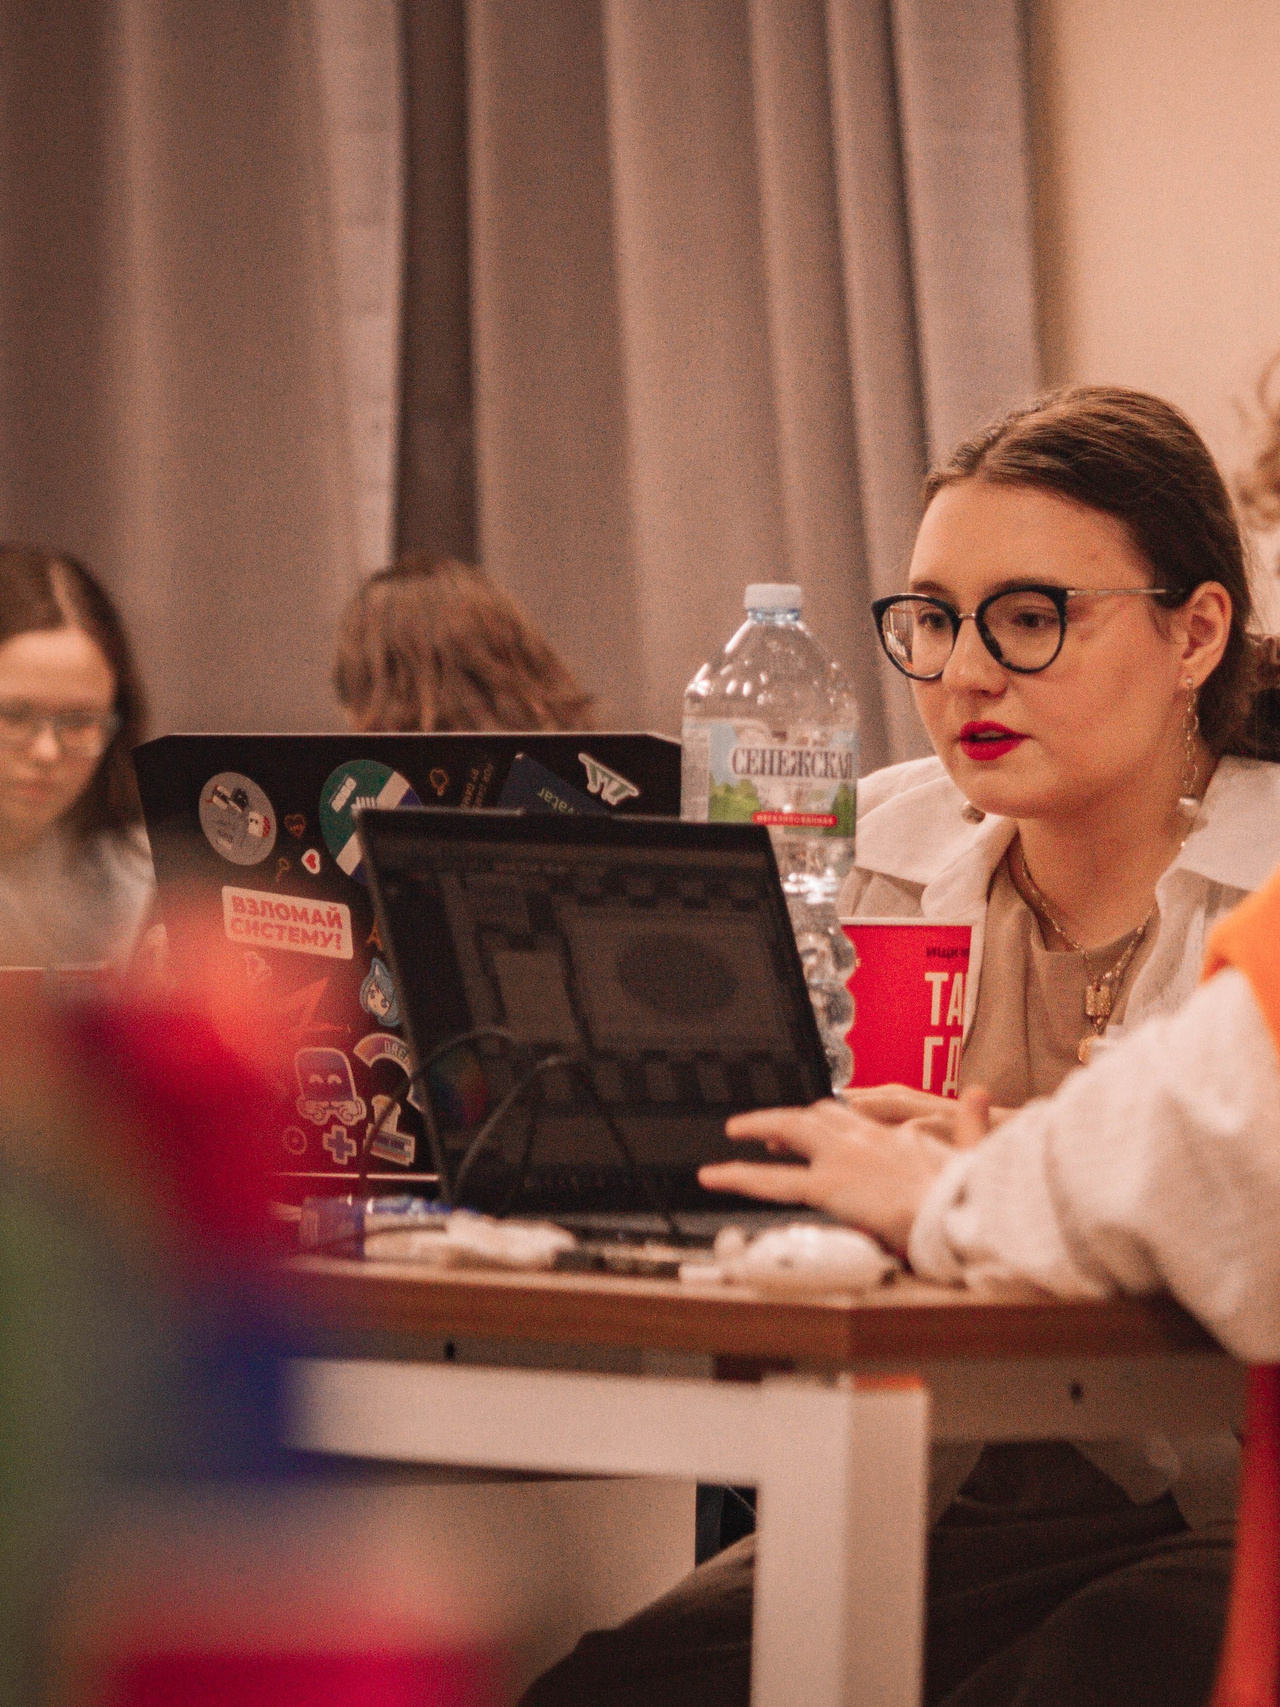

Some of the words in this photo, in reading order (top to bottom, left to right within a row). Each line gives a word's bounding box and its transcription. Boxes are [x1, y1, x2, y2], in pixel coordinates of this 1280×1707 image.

[537, 787, 575, 815] vatar
[230, 895, 342, 930] ВЗЛОМАЙ
[230, 917, 342, 951] СИСТЕМУ!
[924, 972, 967, 1026] ТА
